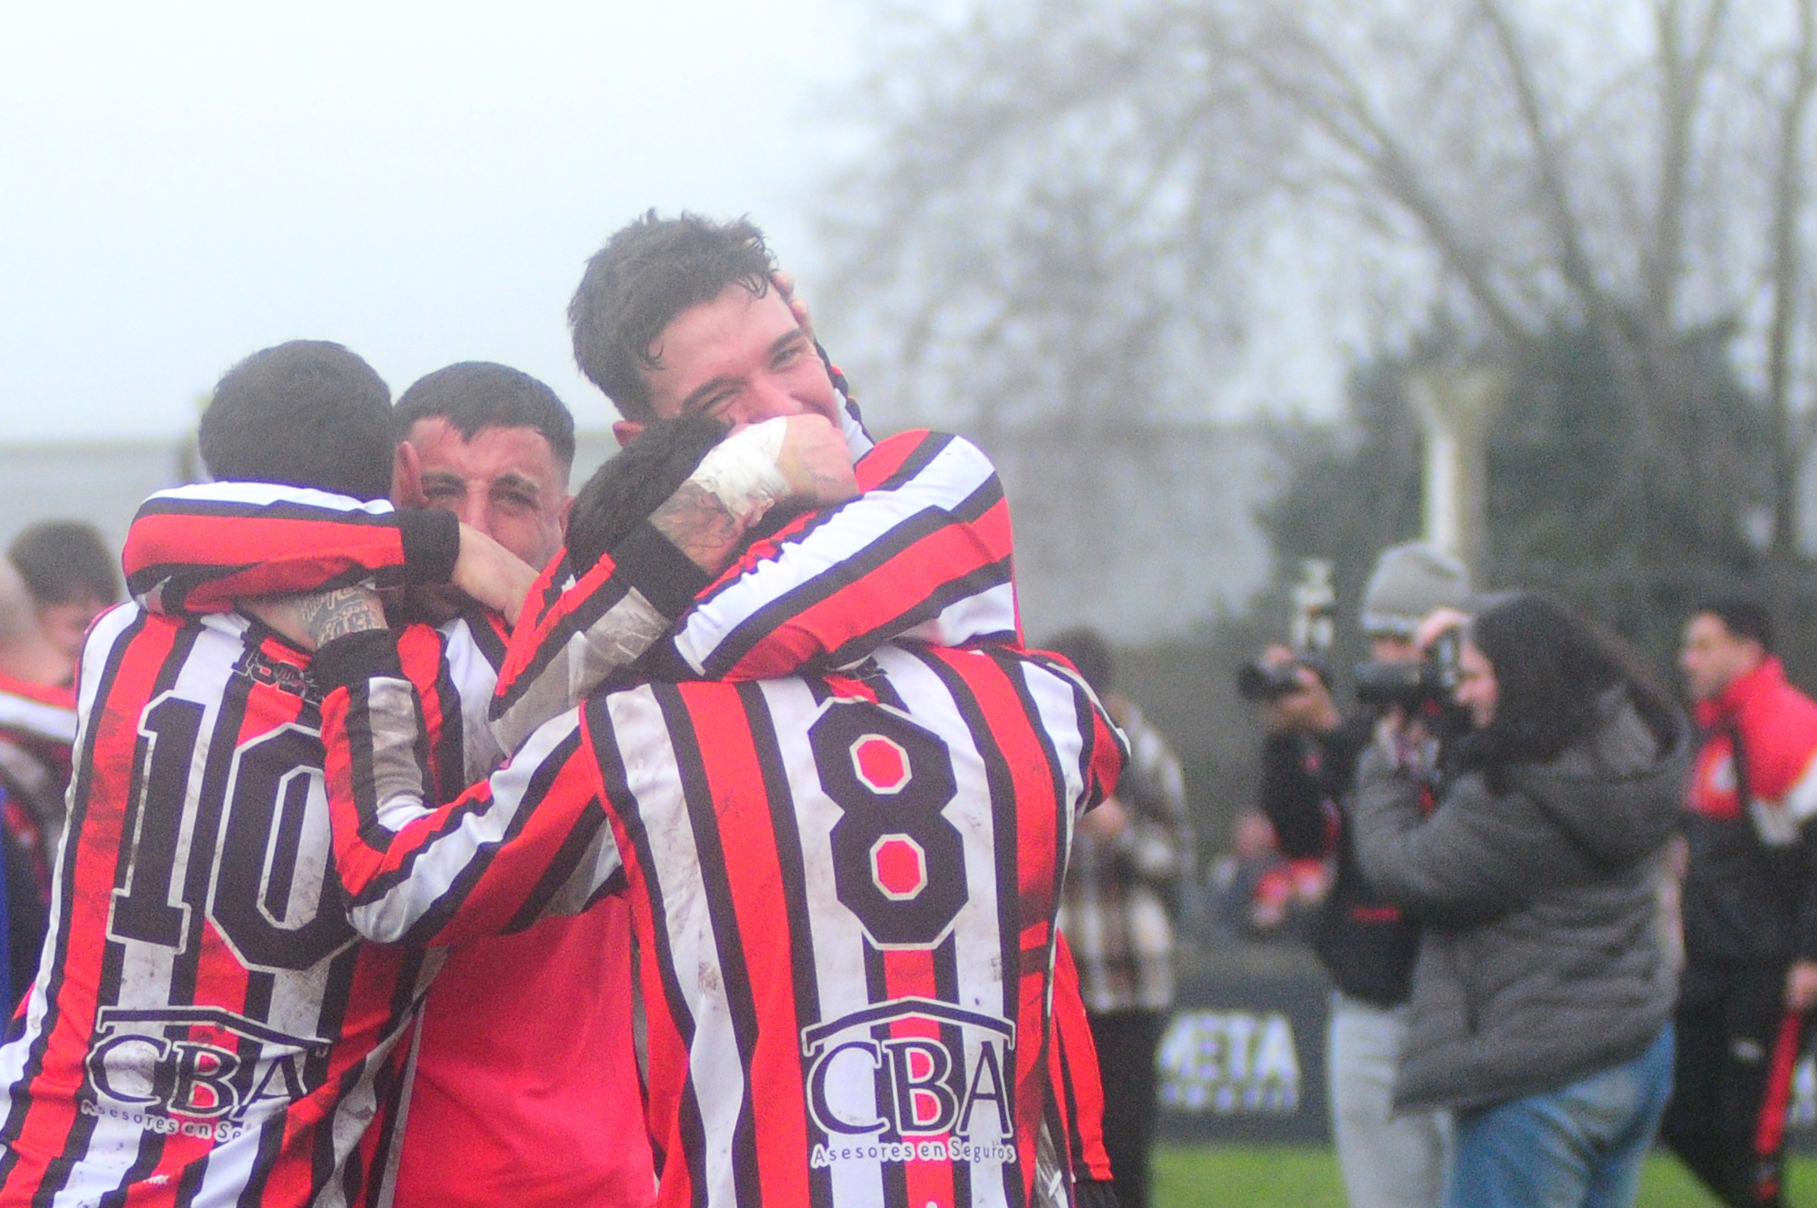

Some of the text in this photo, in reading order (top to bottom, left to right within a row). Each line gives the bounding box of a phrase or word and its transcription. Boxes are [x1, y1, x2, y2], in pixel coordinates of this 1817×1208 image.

[105, 689, 360, 974] 10
[806, 694, 969, 951] 8
[86, 1033, 308, 1122] CBA
[806, 1036, 1013, 1137] CBA
[183, 1120, 211, 1139] en
[812, 1137, 1016, 1168] Asesores en Seguros
